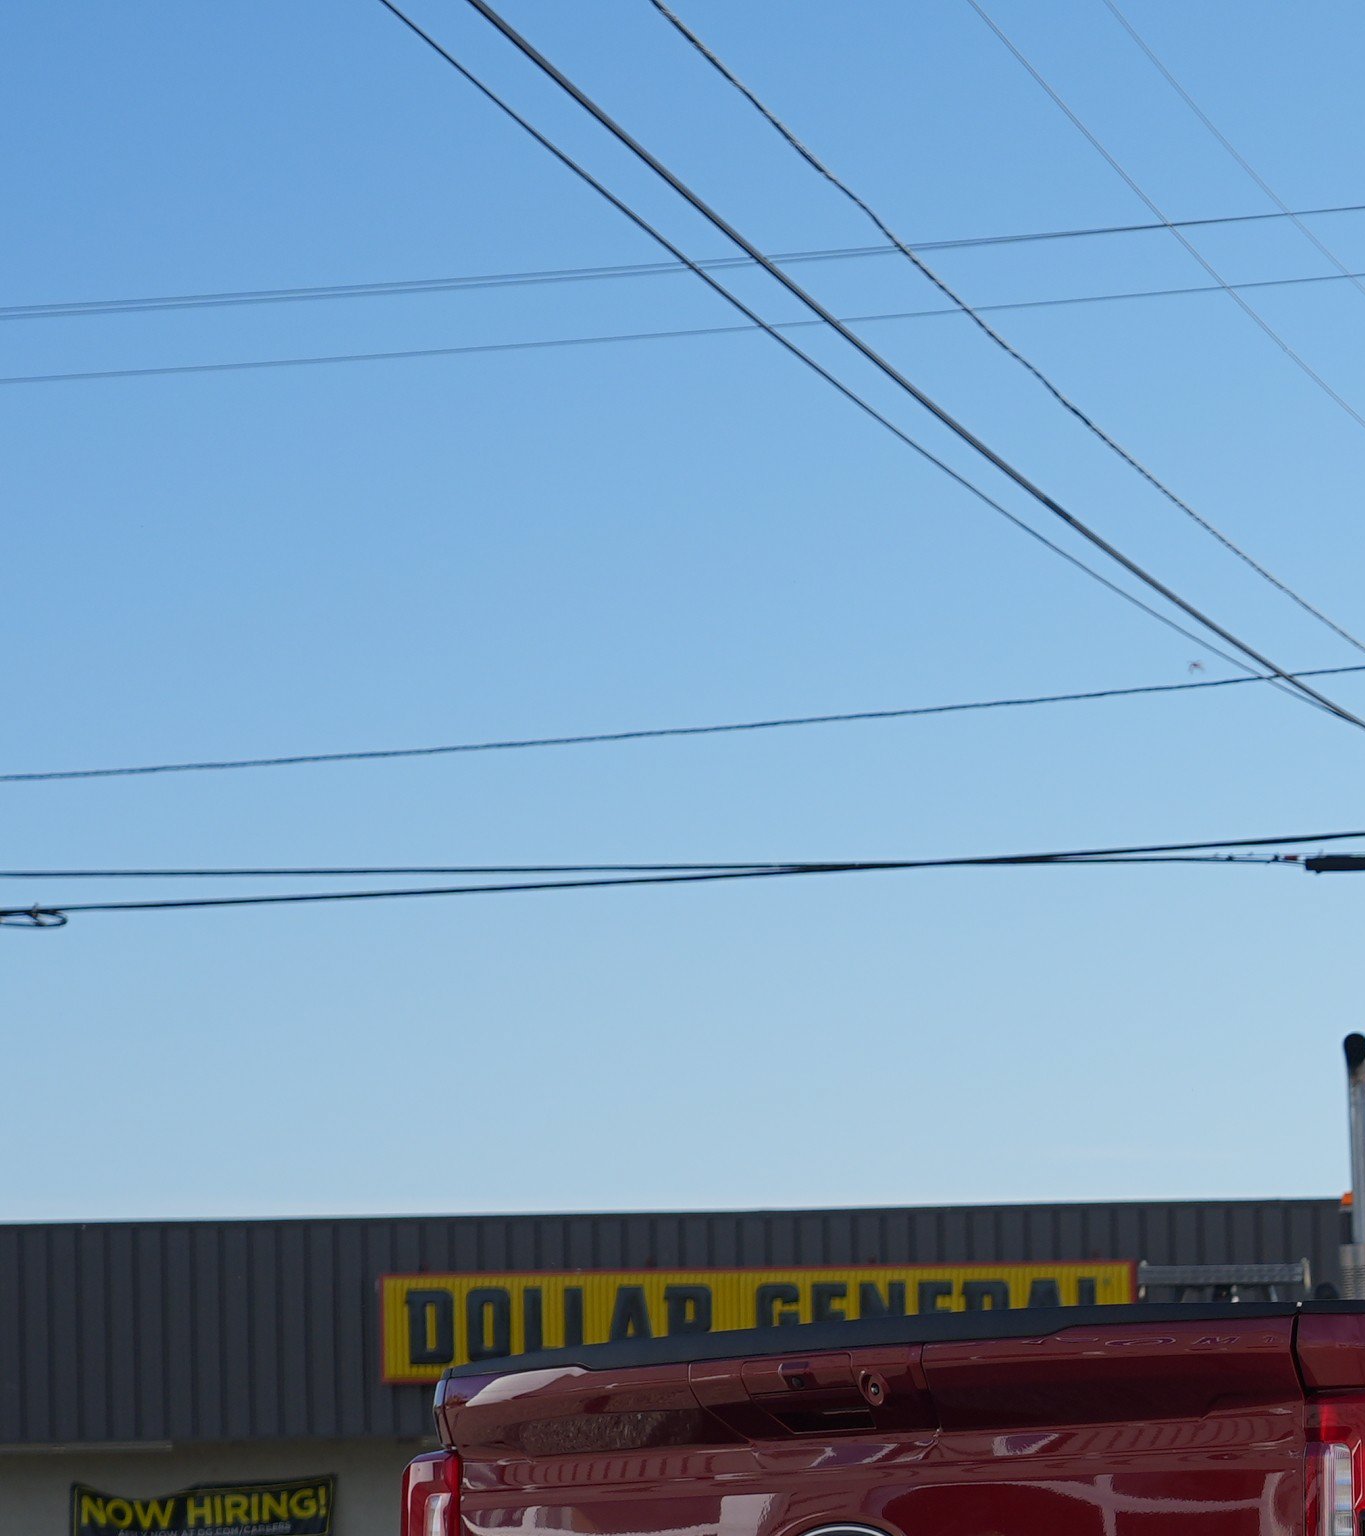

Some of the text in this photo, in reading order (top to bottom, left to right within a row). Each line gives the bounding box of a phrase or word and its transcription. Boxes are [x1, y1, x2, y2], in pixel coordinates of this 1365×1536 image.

[405, 1283, 712, 1364] DOLLAR
[80, 1486, 327, 1529] NOW HIRING!
